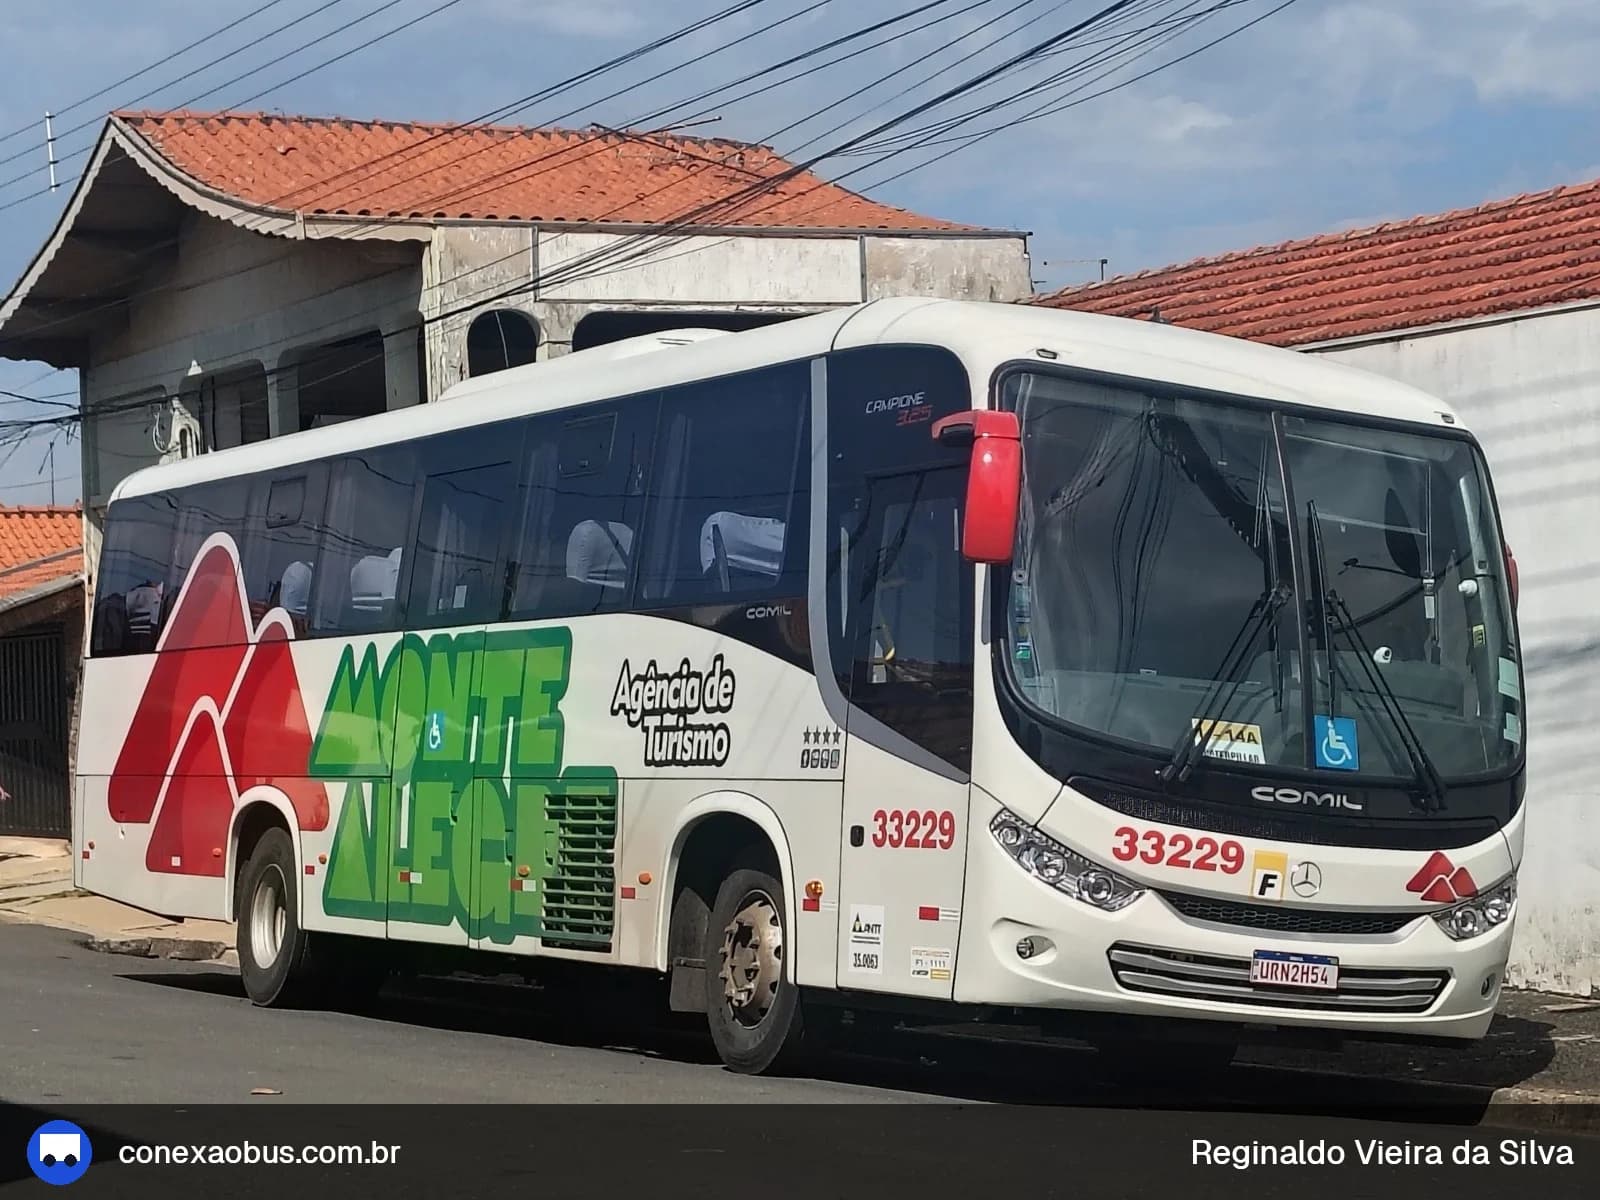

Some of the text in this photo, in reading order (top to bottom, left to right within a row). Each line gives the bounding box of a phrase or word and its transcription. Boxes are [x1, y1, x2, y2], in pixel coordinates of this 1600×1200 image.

[865, 391, 925, 414] CAMPIONE
[746, 605, 792, 619] COMIL
[309, 627, 573, 777] MONTE
[610, 653, 736, 728] Agência de
[642, 714, 731, 767] Turismo
[1198, 727, 1260, 745] -14A
[1203, 749, 1261, 764] ATERPILLAR
[1251, 786, 1363, 811] COMIL
[872, 809, 956, 850] 33229
[1112, 826, 1245, 875] 33229
[1258, 873, 1278, 896] F
[1260, 961, 1329, 985] URN2H54
